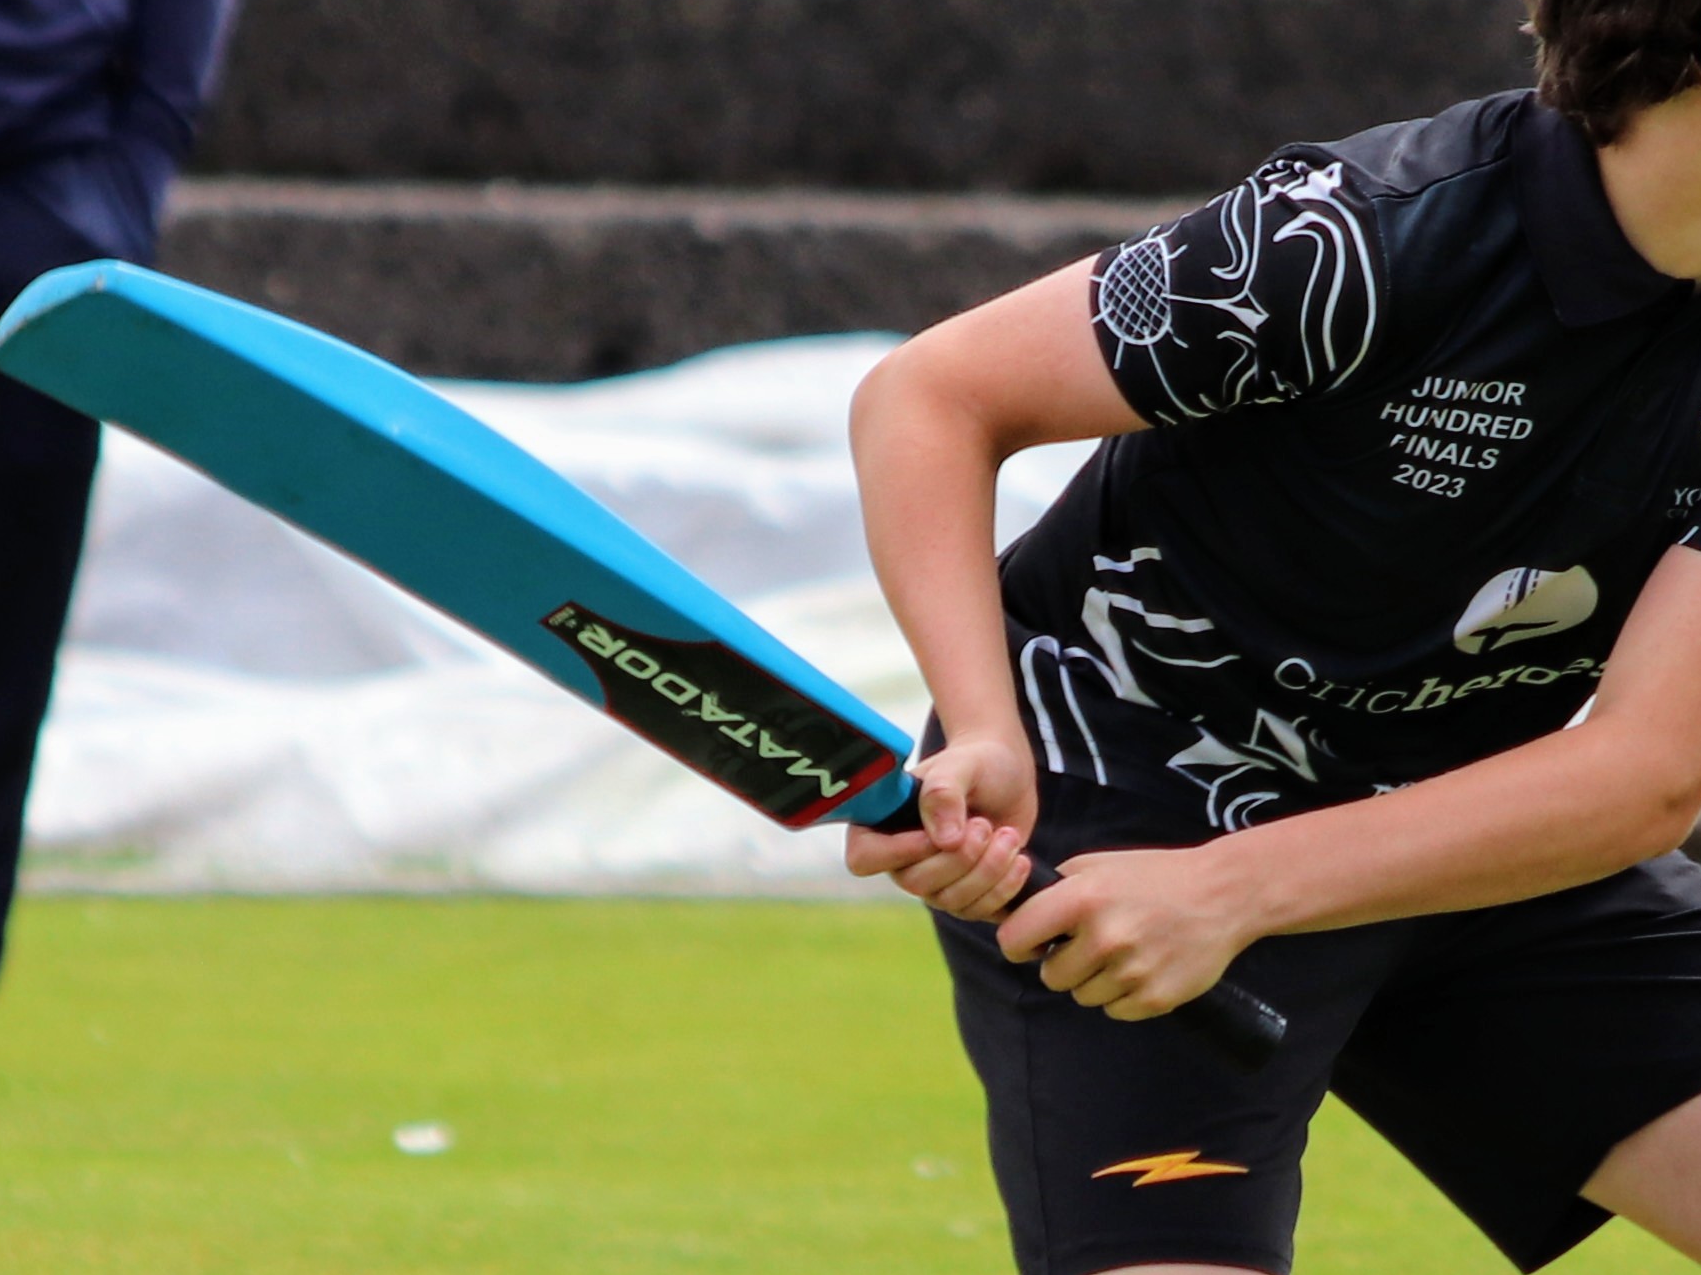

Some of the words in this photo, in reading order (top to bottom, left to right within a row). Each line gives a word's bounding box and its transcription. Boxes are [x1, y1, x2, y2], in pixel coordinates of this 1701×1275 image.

[1411, 376, 1526, 406] JUNIOR
[1380, 402, 1533, 440] HUNDRED
[1389, 434, 1499, 470] FINALS
[1392, 463, 1466, 498] 2023
[577, 623, 848, 798] MATADOR
